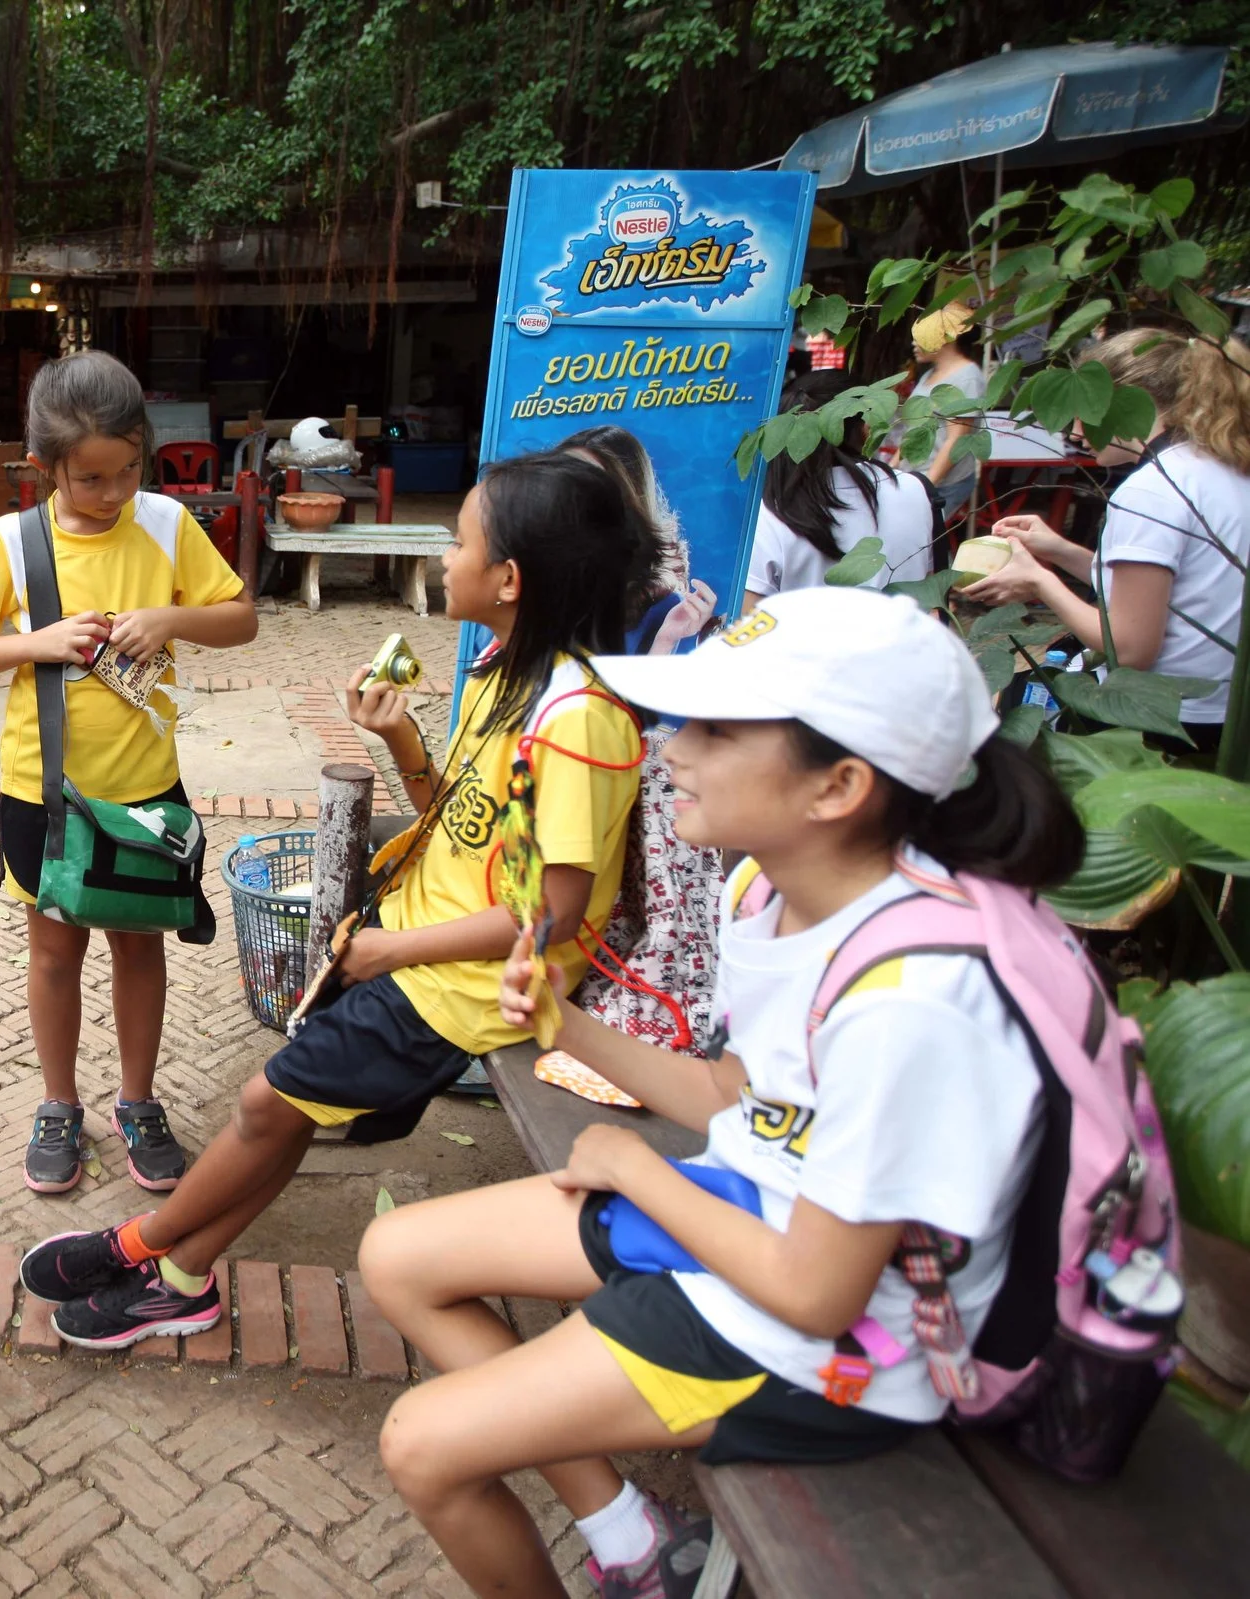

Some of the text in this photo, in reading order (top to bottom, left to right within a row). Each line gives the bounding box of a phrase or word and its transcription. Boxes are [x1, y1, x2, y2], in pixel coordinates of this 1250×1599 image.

[626, 197, 660, 210] ไอศกรีม
[579, 237, 737, 295] เอ็กซ์ตรีม
[544, 337, 731, 384] ยอมได้หมด
[510, 386, 630, 419] เพื่อรสชาติ
